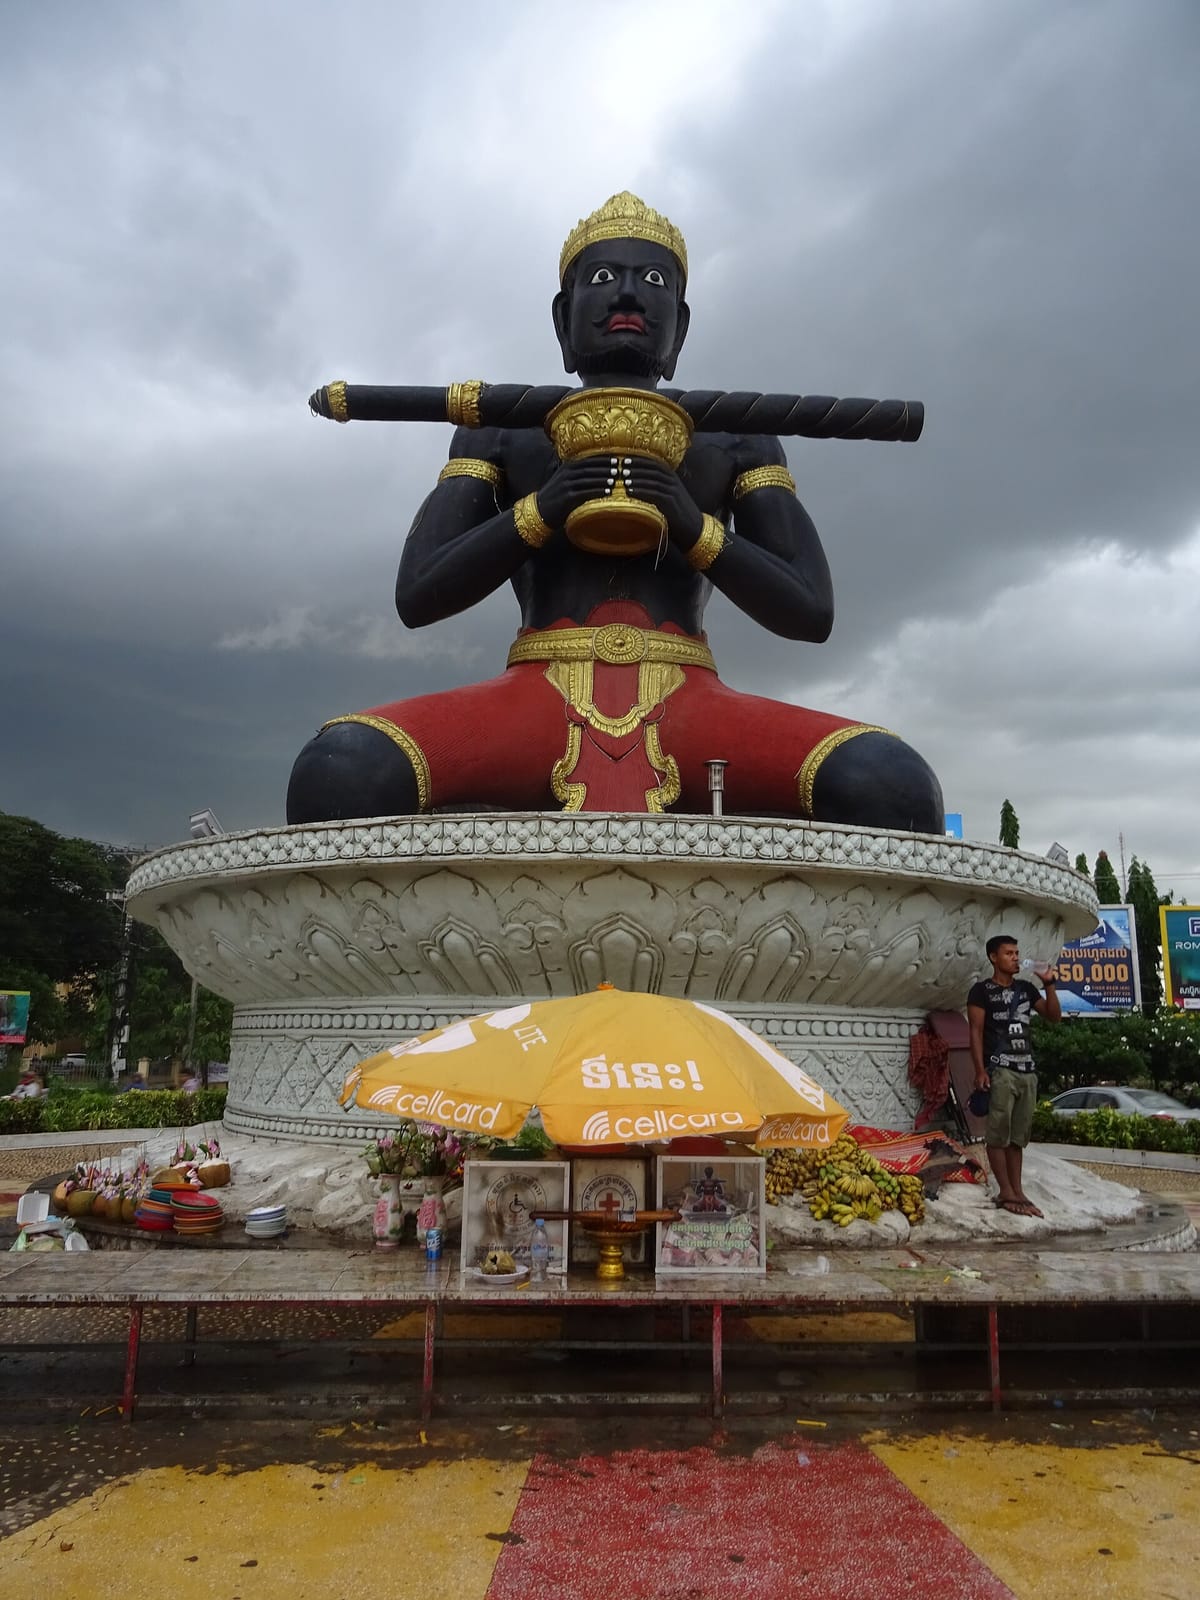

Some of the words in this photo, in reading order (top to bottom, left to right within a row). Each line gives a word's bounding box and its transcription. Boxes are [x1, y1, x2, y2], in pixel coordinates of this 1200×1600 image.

[513, 1024, 547, 1051] LTE
[396, 1090, 502, 1129] cellcard
[771, 1116, 829, 1142] cellcard
